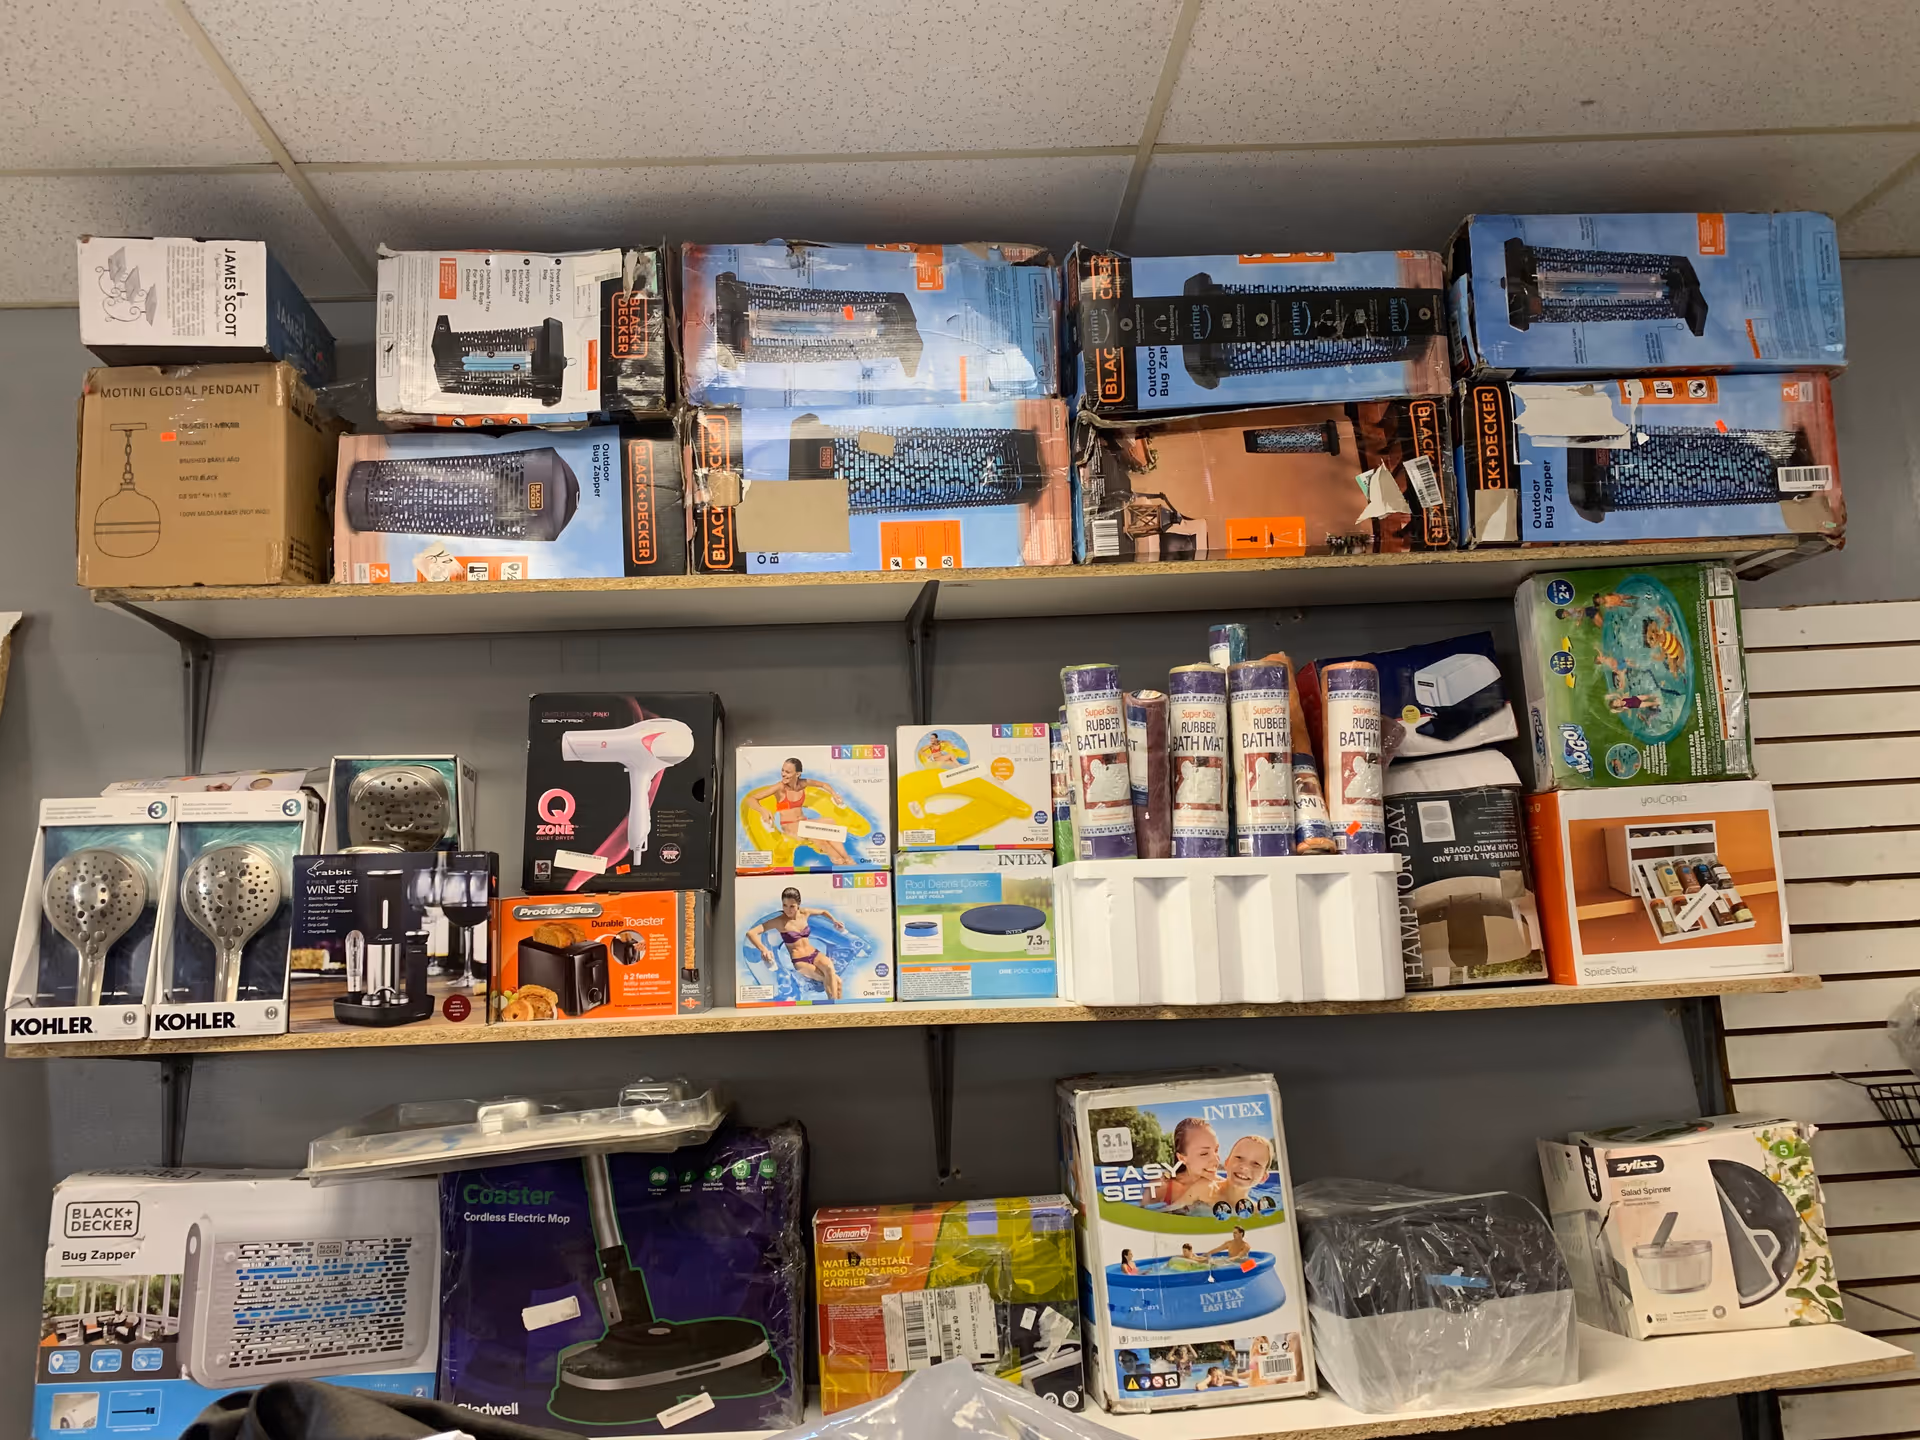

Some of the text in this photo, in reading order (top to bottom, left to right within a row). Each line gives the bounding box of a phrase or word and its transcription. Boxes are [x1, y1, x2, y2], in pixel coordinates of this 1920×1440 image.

[225, 248, 236, 337] JAMES SCOTT
[1190, 304, 1204, 340] prime
[1289, 301, 1303, 336] prime
[1388, 298, 1401, 332] prime
[618, 298, 629, 354] DECKER
[630, 298, 641, 352] BLACK+
[1089, 309, 1099, 345] prime
[1148, 346, 1157, 397] Outdoor
[1160, 346, 1170, 397] Bug Zap
[100, 384, 260, 398] MOTINI GLOBAL PENDANT
[1481, 392, 1501, 491] CK+DECKER
[602, 443, 610, 482] Outdoor
[592, 444, 601, 498] Bug Zapper
[1543, 459, 1555, 529] Bug Zapper
[634, 446, 650, 559] BLACK+DECKER
[1532, 480, 1542, 529] Outdoor
[1558, 584, 1570, 600] 2+
[1701, 604, 1706, 613] DE
[1702, 612, 1710, 650] ALMOHADILLA
[1706, 666, 1716, 694] ARROSEUR
[994, 726, 1044, 737] INTEX
[1086, 717, 1121, 732] RUBBER
[1181, 721, 1217, 734] RUBBER
[1253, 717, 1287, 730] RUBBER
[1077, 731, 1127, 751] BATH MA
[1242, 731, 1291, 749] BATH MA
[1339, 731, 1371, 747] BATH
[1695, 692, 1708, 776] ALMOHADILLA DE ROCIADORES
[1173, 735, 1225, 753] BATH MAT
[834, 747, 886, 759] INTEX
[1689, 746, 1697, 776] SPRINKLER
[285, 801, 297, 816] 3
[538, 788, 576, 825] Q
[1640, 794, 1688, 807] youCopia
[150, 802, 162, 818] 3
[536, 824, 575, 835] ZONE
[1389, 803, 1410, 849] BAY
[1443, 842, 1519, 854] CHAIR PATIO COVER
[997, 854, 1048, 867] INTEX
[1432, 850, 1520, 863] UNIVERSAL TABLE AND
[315, 868, 353, 877] rabbit
[835, 875, 886, 887] INTEX
[905, 878, 990, 889] Pool Debris Cover
[306, 884, 359, 895] WINE SET
[519, 906, 595, 916] Proctor Silex
[1398, 853, 1424, 979] HAMPTON
[591, 916, 665, 929] Durable Toaster
[636, 972, 660, 980] fentes
[1583, 965, 1639, 977] SpiceStack
[681, 987, 700, 995] Proven.
[10, 1016, 94, 1036] KOHLER
[154, 1011, 236, 1031] KOHLER
[1202, 1101, 1265, 1121] INTEX
[1779, 1145, 1789, 1156] 5
[1100, 1160, 1184, 1184] EASY
[1616, 1159, 1658, 1173] zyliss
[1584, 1154, 1599, 1197] zyliss
[463, 1183, 555, 1206] Coaster
[1103, 1182, 1162, 1203] SET
[1621, 1186, 1672, 1197] Salad Spinner
[72, 1207, 133, 1220] BLACK+
[463, 1211, 571, 1225] Cordless Electric Mop
[71, 1220, 133, 1232] DECKER
[826, 1228, 860, 1240] Coleman
[62, 1249, 136, 1262] Bug Zapper
[859, 1255, 912, 1267] RESISTANT
[822, 1266, 908, 1278] ROOFTOP CARGO
[822, 1278, 866, 1288] CARRIER
[1199, 1287, 1245, 1306] INTEX
[1203, 1301, 1242, 1313] EASY SET
[415, 1387, 424, 1397] 2
